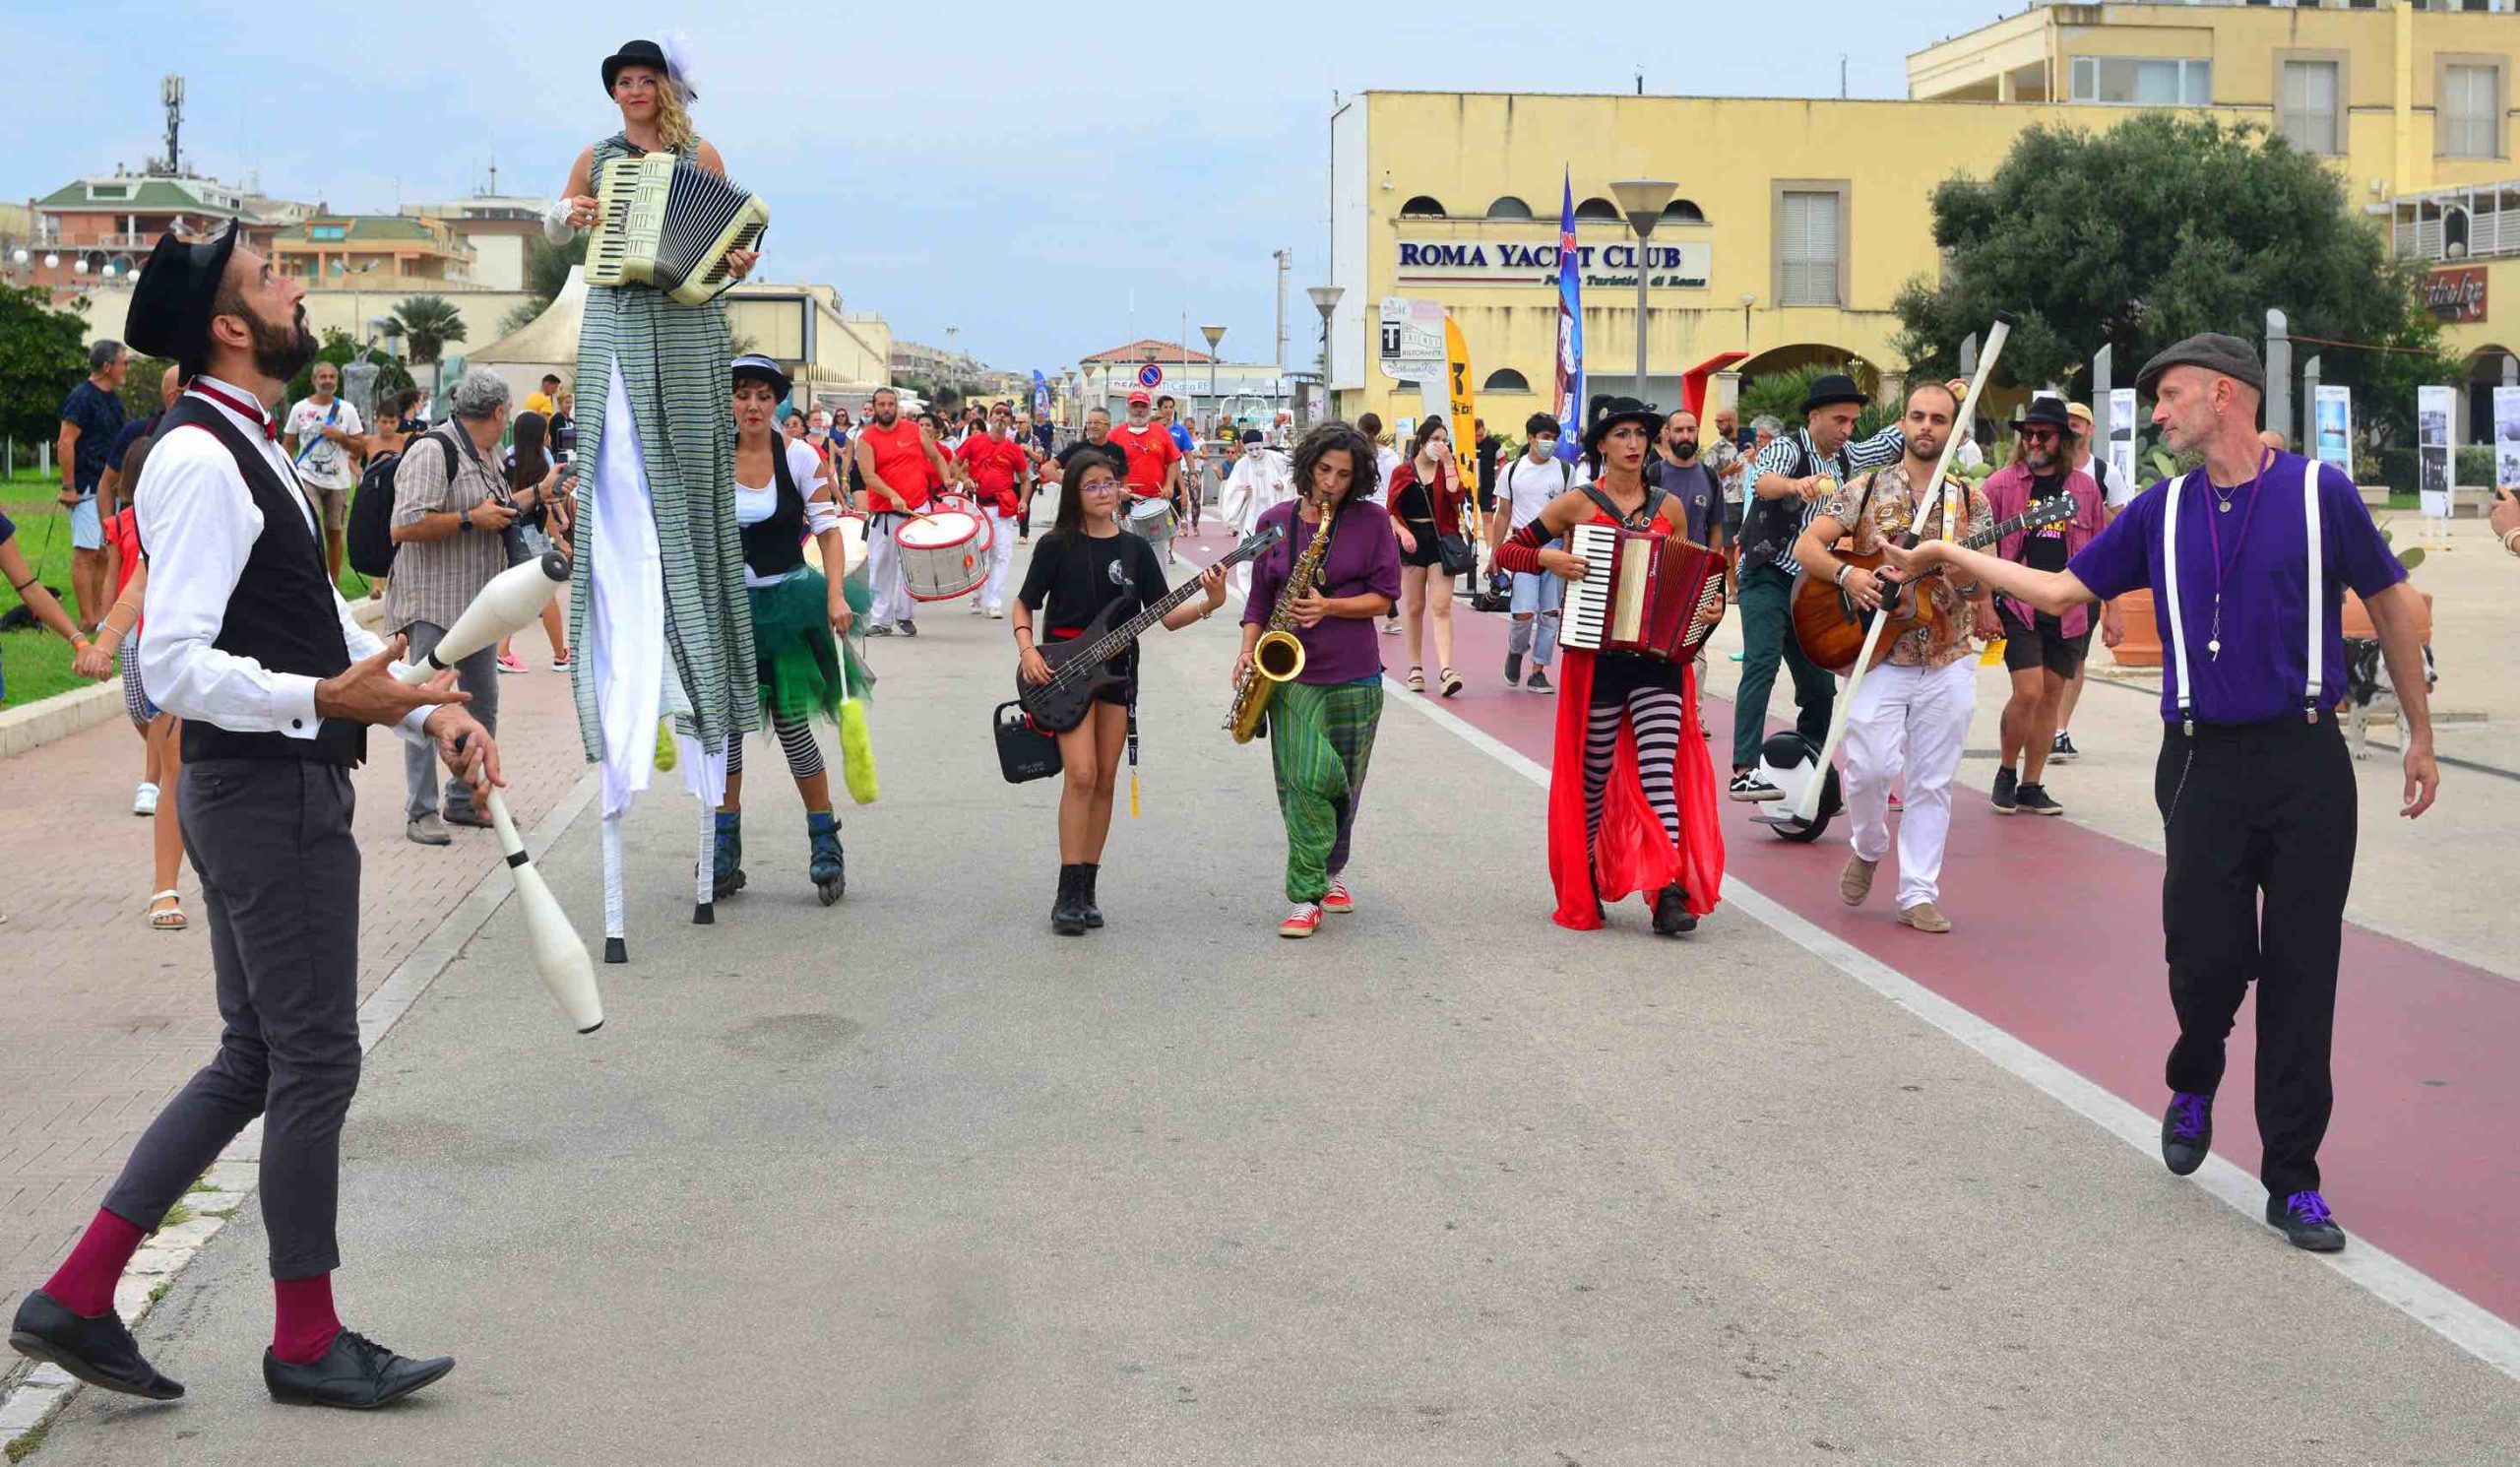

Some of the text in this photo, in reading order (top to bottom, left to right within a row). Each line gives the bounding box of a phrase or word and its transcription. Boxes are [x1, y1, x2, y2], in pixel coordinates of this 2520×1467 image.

[1399, 243, 1488, 267] ROMA
[1603, 244, 1681, 268] CLUB
[1651, 275, 1665, 287] di
[1669, 276, 1707, 287] Roma
